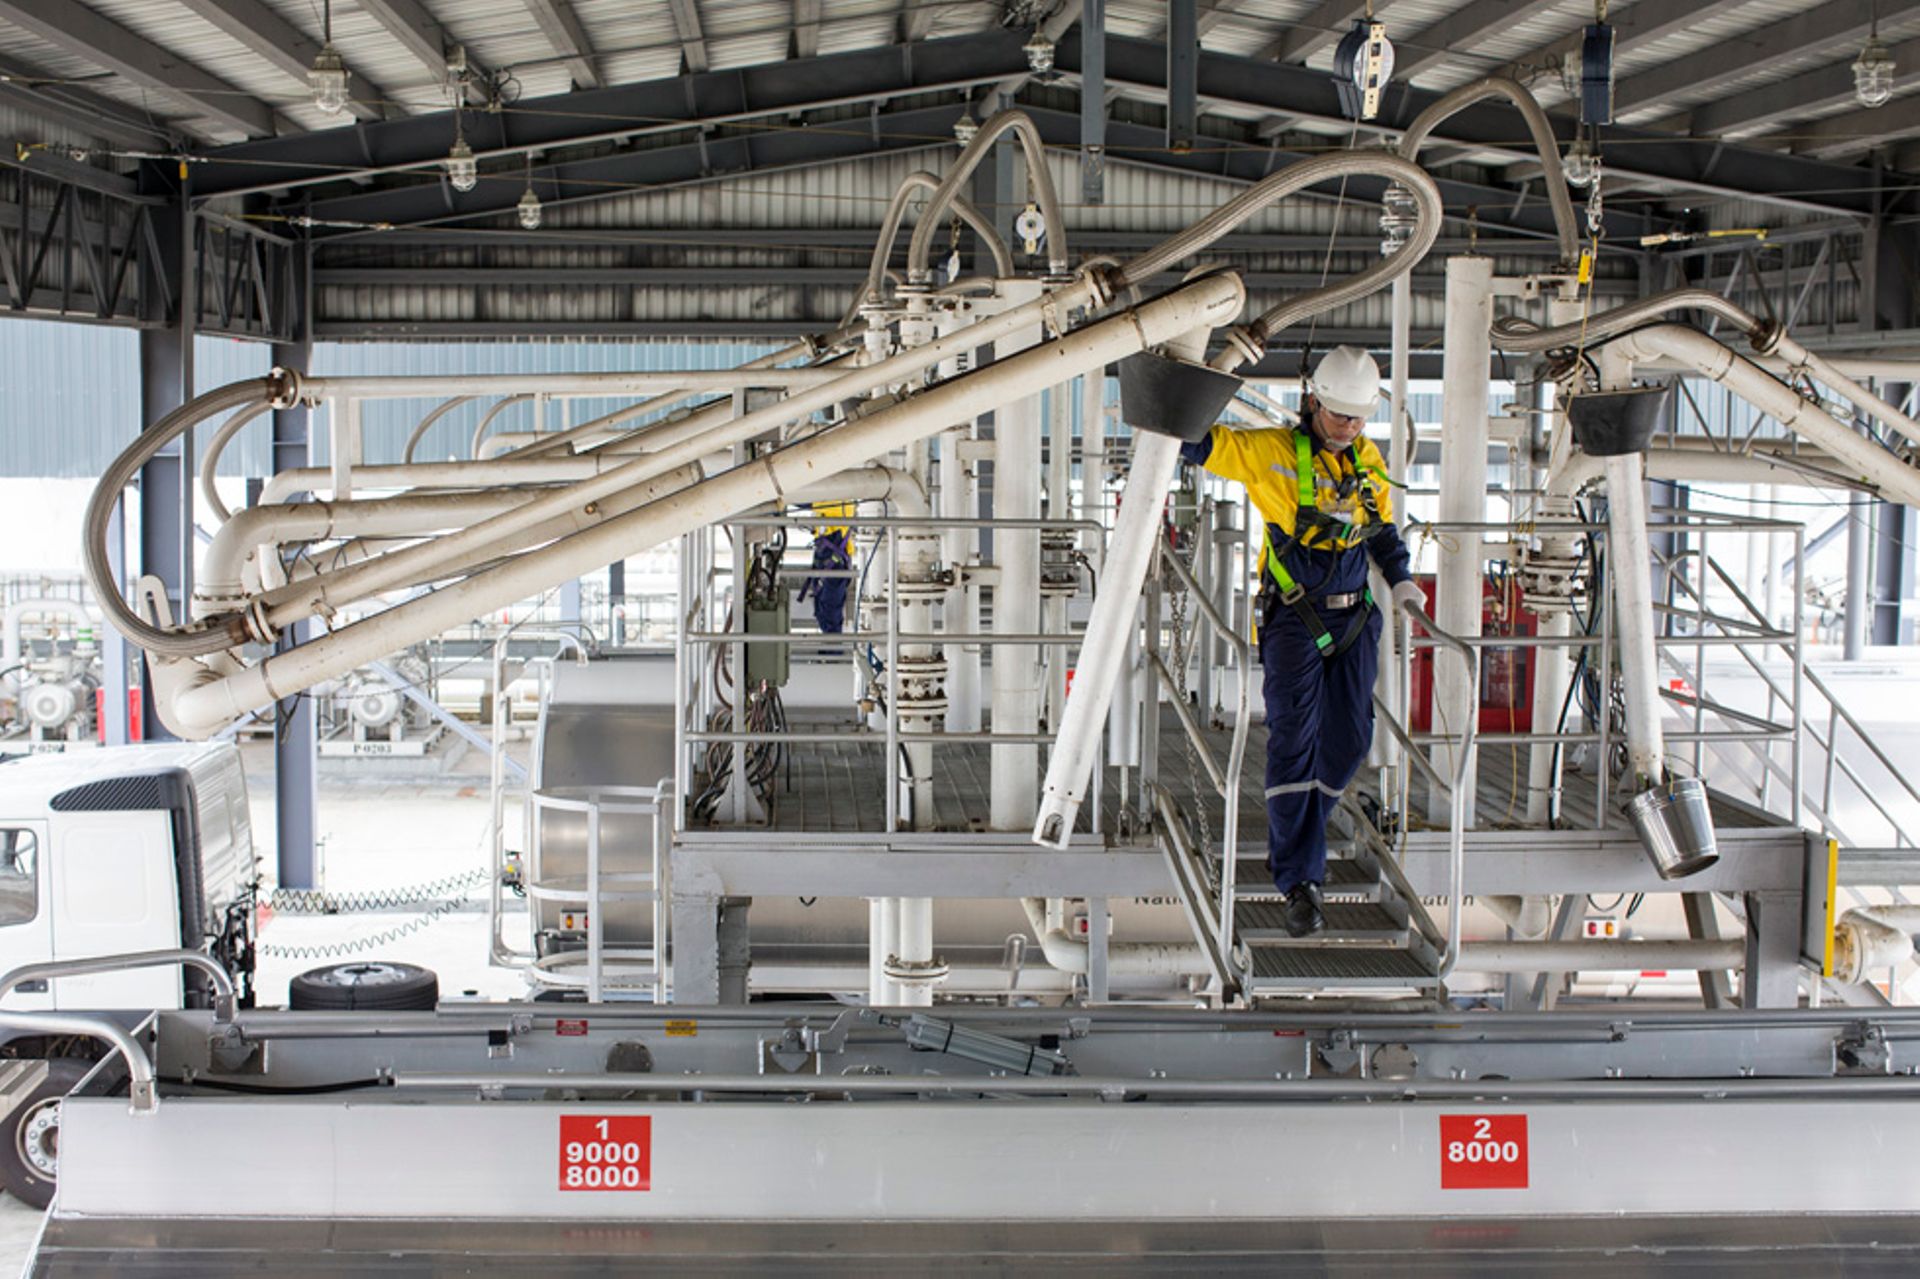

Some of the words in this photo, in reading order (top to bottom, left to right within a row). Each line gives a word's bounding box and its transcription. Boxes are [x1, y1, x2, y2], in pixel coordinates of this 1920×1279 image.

[595, 1118, 609, 1141] 1
[1474, 1117, 1492, 1140] 2
[566, 1141, 640, 1164] 9000
[1448, 1140, 1519, 1163] 8000
[566, 1165, 640, 1188] 8000
